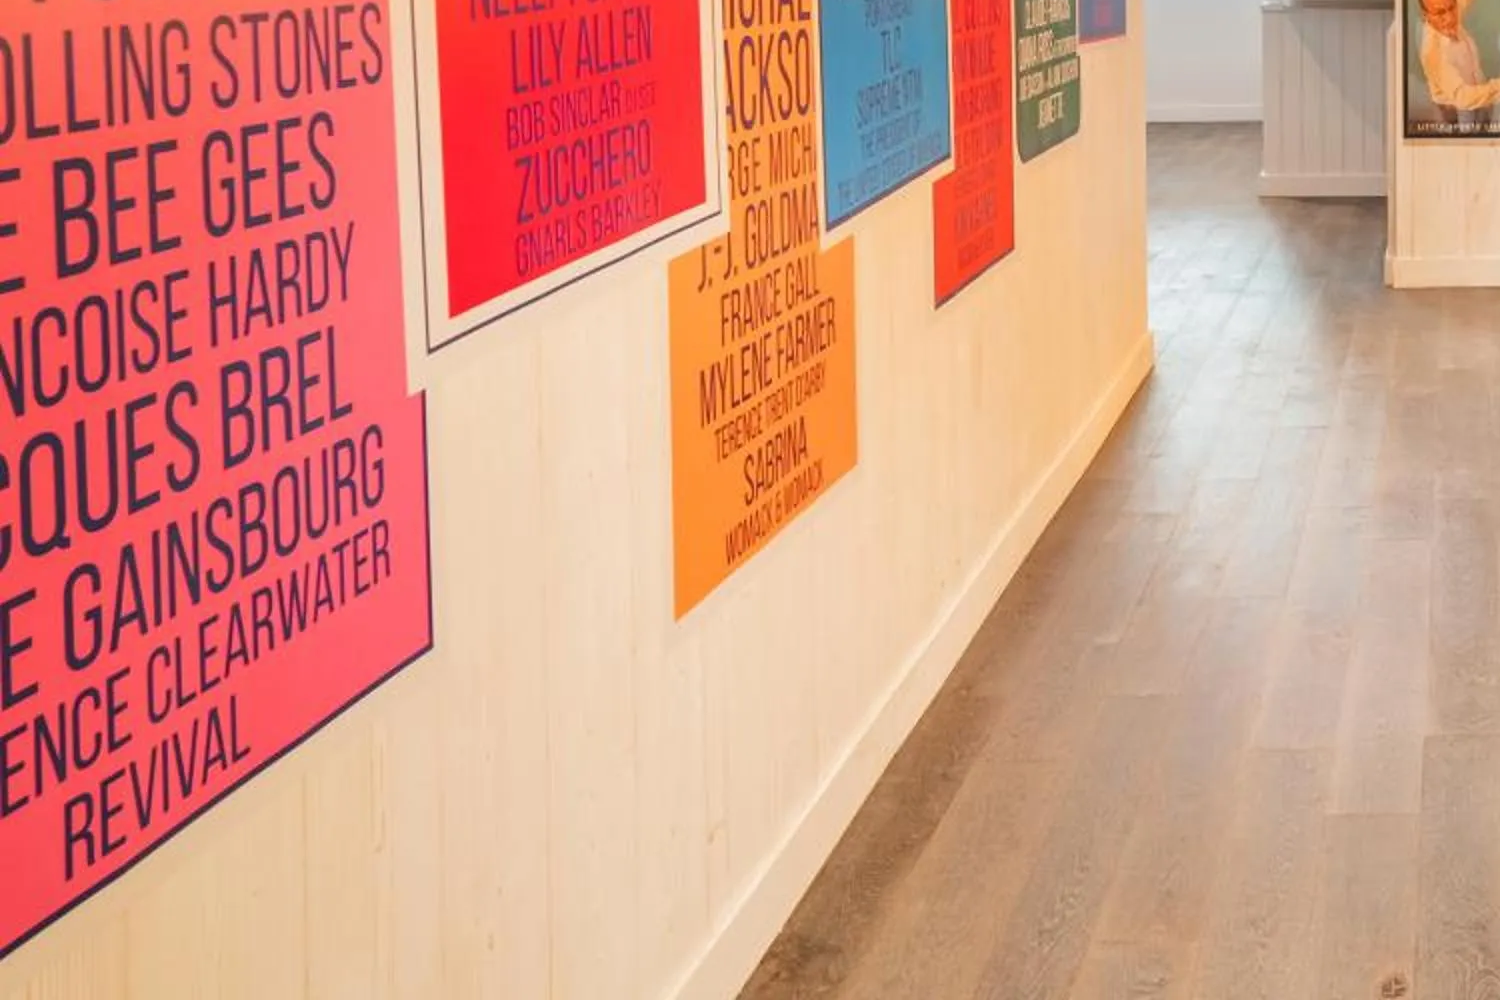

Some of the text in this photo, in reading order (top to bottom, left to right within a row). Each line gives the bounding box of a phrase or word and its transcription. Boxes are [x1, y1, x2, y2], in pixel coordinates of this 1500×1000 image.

[210, 2, 383, 108] STONES
[510, 5, 652, 93] LILY ALLEN
[724, 27, 816, 133] CKSO
[880, 26, 902, 75] TLC
[507, 100, 545, 151] BOB
[550, 79, 620, 137] SINCLAR
[769, 122, 816, 186] MICH
[52, 139, 182, 279] BEE
[202, 111, 336, 238] GEES
[516, 118, 651, 224] ZUCCHERO
[515, 179, 662, 277] GNARLS BARKLEY
[207, 220, 355, 348] HARDY
[721, 252, 820, 347] FRANCE GALL
[700, 296, 836, 429] MYLENE FARMER
[0, 326, 353, 573] QUES BREL
[714, 401, 763, 463] TERENCE
[765, 380, 794, 427] TRENT
[743, 415, 809, 507] SABRINA
[63, 424, 385, 672] GAINSBOURG
[725, 503, 775, 566] WOMACK
[783, 458, 825, 515] WOMACK
[146, 519, 391, 725] CLEARWATER
[63, 695, 251, 882] REVIVAL
